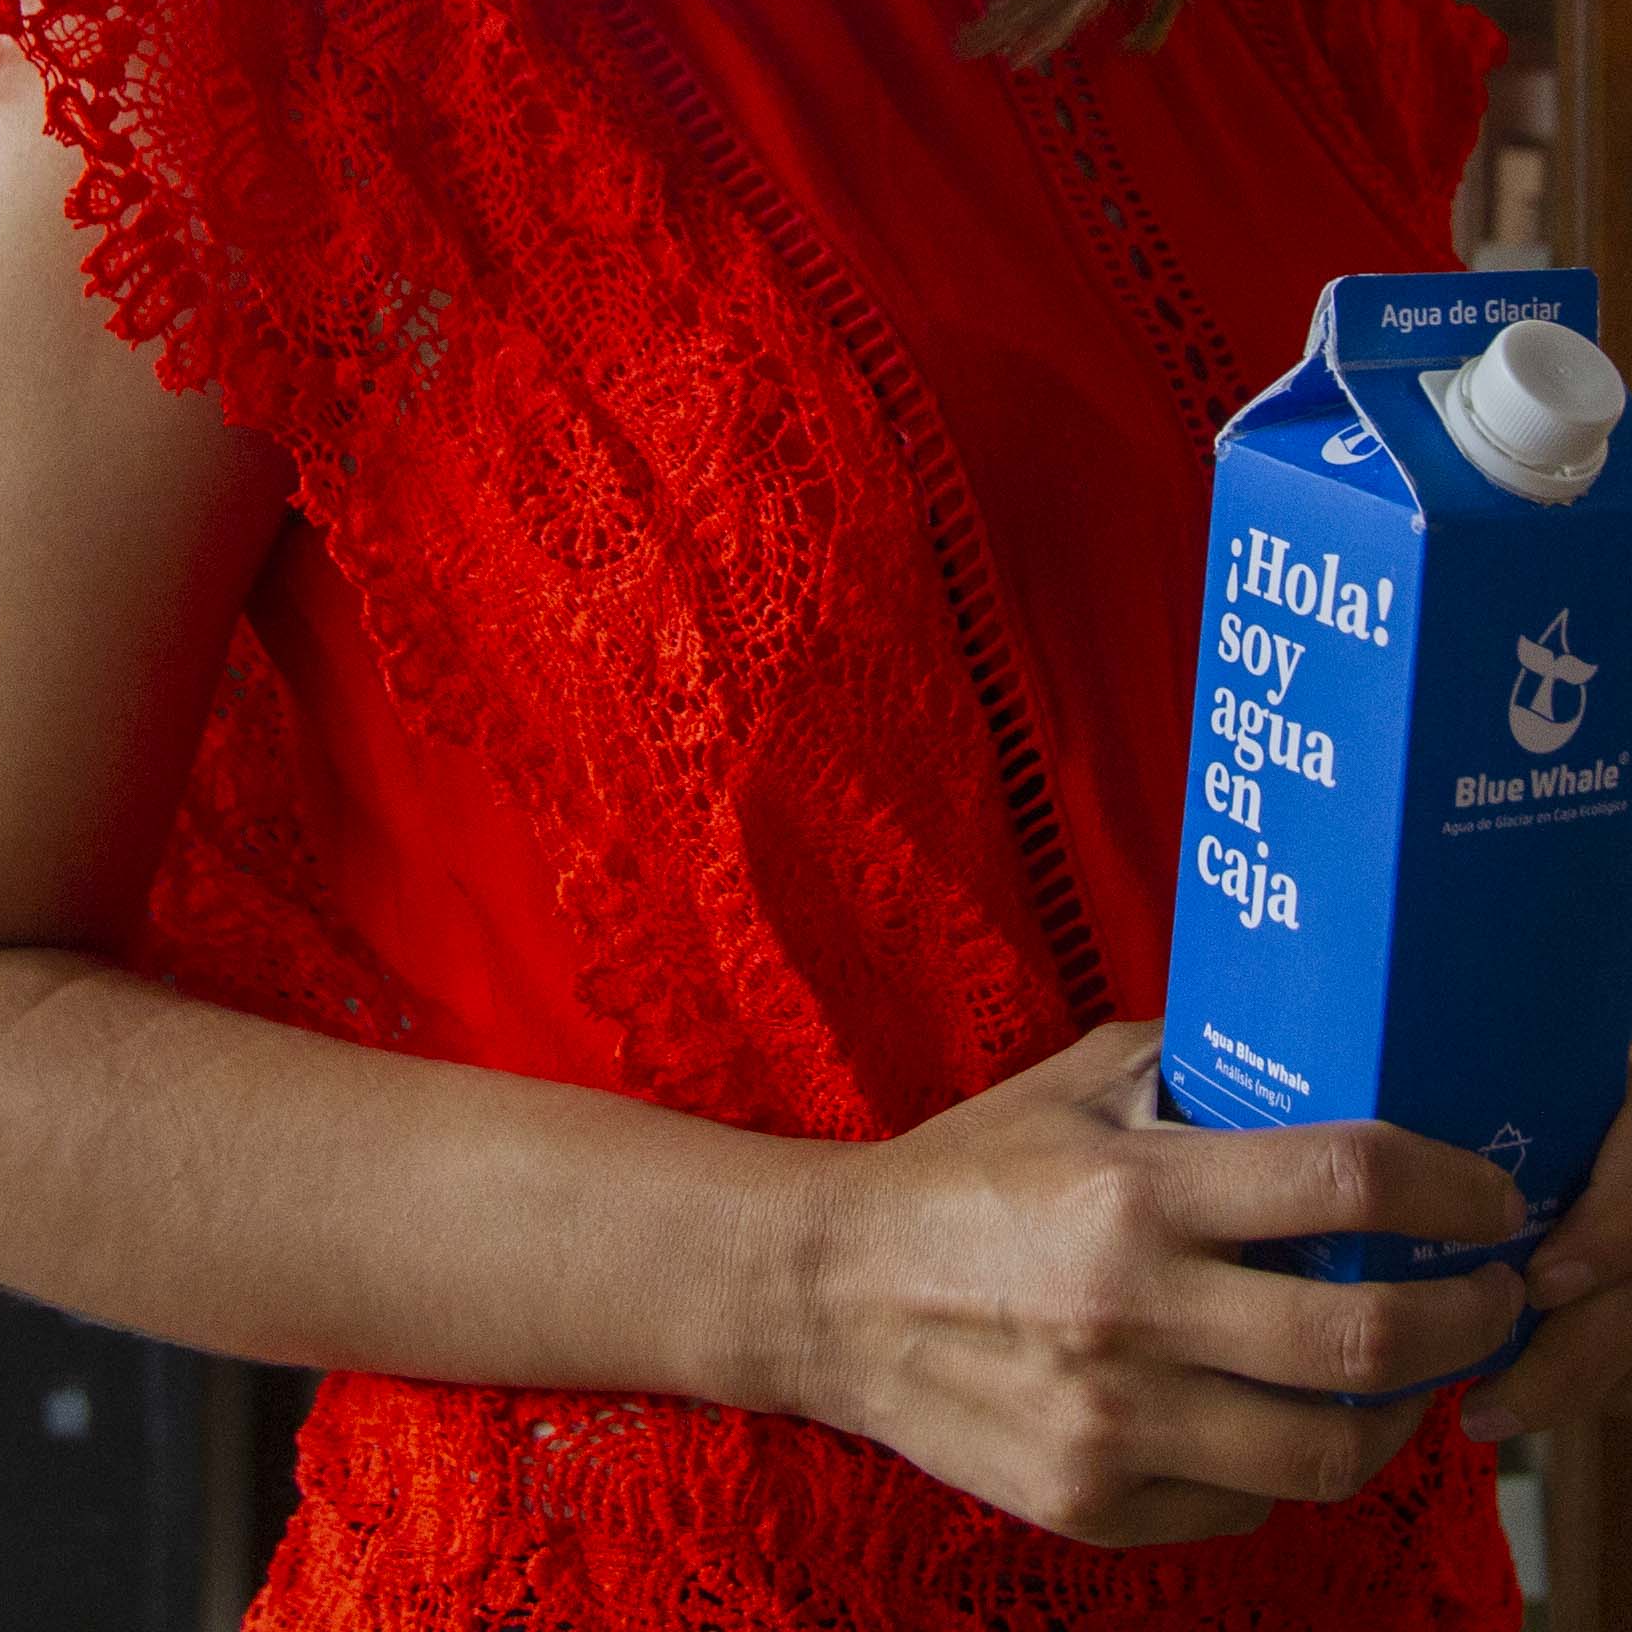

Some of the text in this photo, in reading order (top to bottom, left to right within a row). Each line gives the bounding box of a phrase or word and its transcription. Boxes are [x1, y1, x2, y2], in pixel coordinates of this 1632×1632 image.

[1382, 296, 1562, 334] Agua de Glaciar
[1226, 527, 1394, 648] ¡Hola!
[1217, 612, 1306, 706] soy
[1210, 686, 1336, 788] agua
[1204, 760, 1261, 833] en
[1455, 759, 1619, 808] Blue Whale
[1441, 821, 1474, 837] Agua
[1476, 818, 1492, 831] de
[1495, 814, 1533, 830] Glaciar
[1536, 811, 1552, 824] en
[1554, 807, 1578, 824] Caja
[1197, 834, 1300, 930] caja
[1203, 1021, 1310, 1097] Agua Blue Whale
[1215, 1056, 1292, 1114] Análisis (mg/L)
